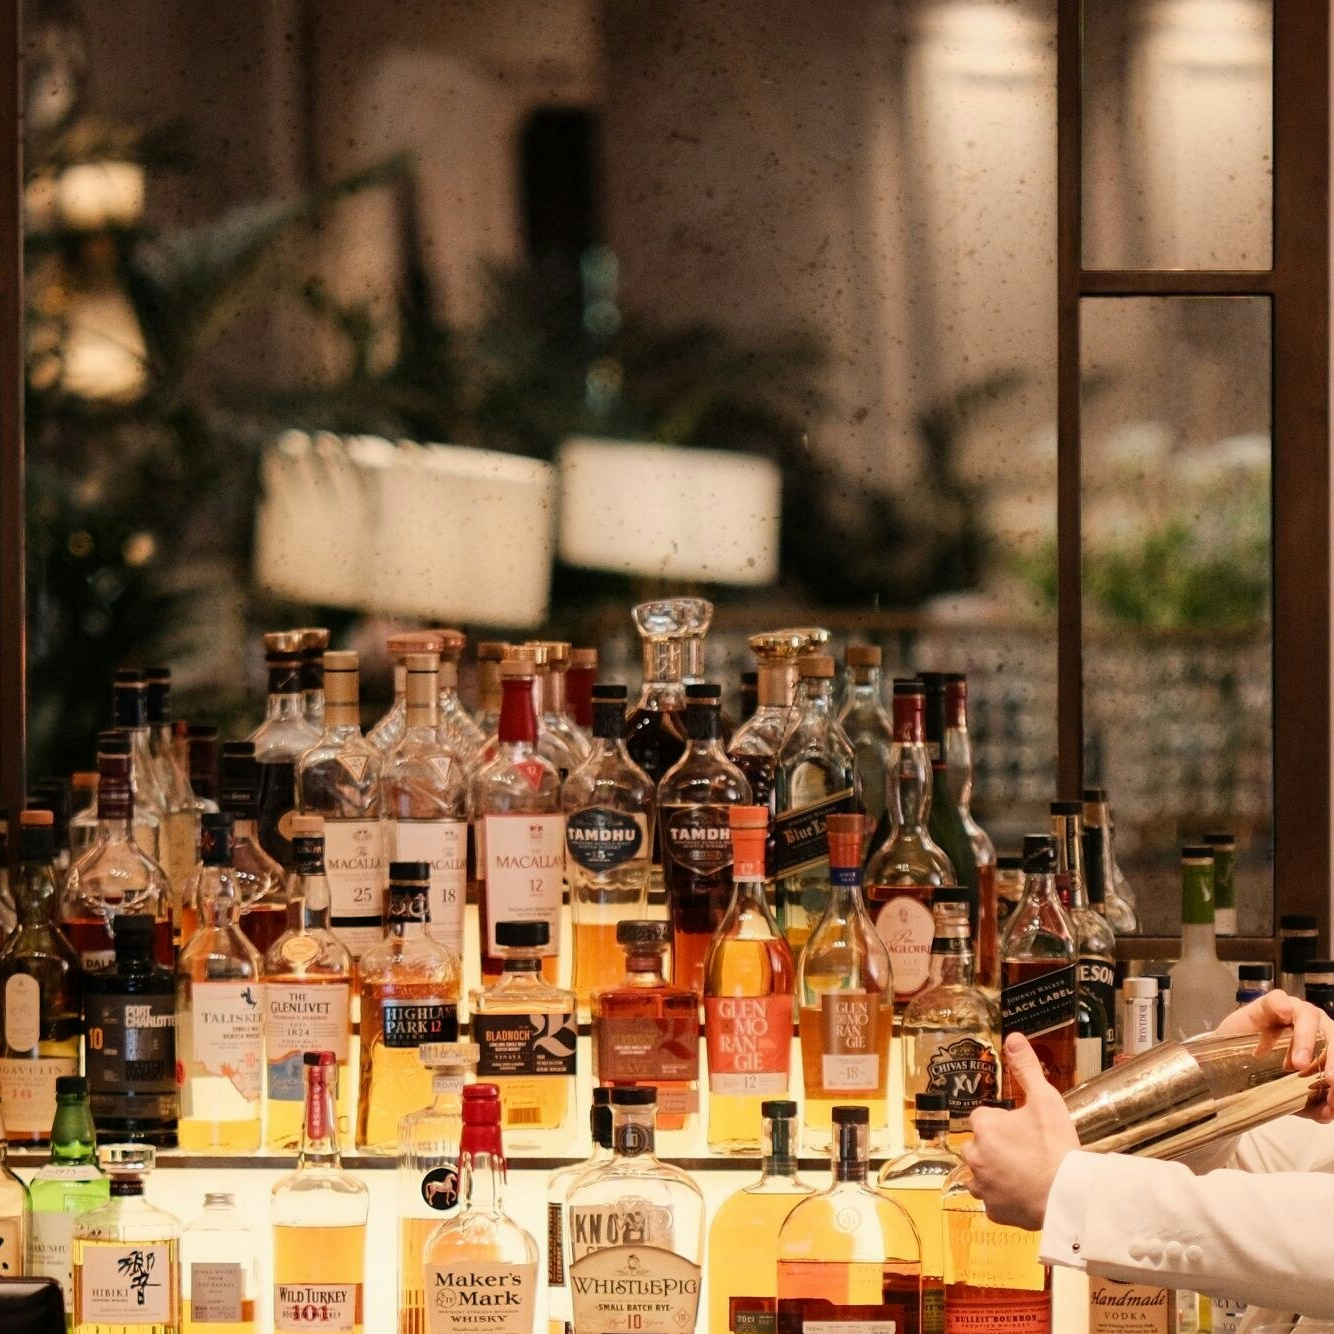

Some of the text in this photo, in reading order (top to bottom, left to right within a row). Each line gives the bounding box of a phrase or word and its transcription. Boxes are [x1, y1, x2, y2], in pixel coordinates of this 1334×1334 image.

[568, 827, 635, 841] TAMDHU
[670, 827, 730, 841] TAMDH
[741, 862, 754, 875] 12
[529, 879, 544, 892] 12
[353, 887, 372, 902] 25
[442, 888, 457, 903] 18
[289, 992, 308, 1001] THE
[1003, 988, 1074, 1018] BLACK LABEL
[270, 1001, 332, 1015] GLENLIVET
[385, 1007, 457, 1021] HIGHLAN
[719, 1000, 766, 1018] GLEN
[836, 1001, 867, 1013] GLEN
[846, 1014, 869, 1025] MO
[287, 1028, 310, 1037] 1824
[385, 1020, 442, 1034] PARK 12
[734, 1019, 768, 1036] MO
[836, 1025, 861, 1037] RAN
[88, 1027, 103, 1050] 10
[485, 1029, 531, 1042] BLADNOCH
[720, 1035, 757, 1053] RAN
[846, 1037, 866, 1049] GIE
[733, 1053, 764, 1071] GIE
[931, 1061, 996, 1075] CHIVAS REGAL
[845, 1067, 859, 1080] 18
[743, 1075, 757, 1089] 12
[953, 1073, 982, 1098] XV
[435, 1272, 522, 1287] Maker's
[92, 1288, 129, 1298] HIBIKI
[279, 1287, 347, 1304] WILD TURKEY
[458, 1290, 522, 1306] Mark
[1091, 1288, 1166, 1307] Handmade
[292, 1304, 329, 1321] 101
[627, 1303, 653, 1312] BATCH
[450, 1315, 508, 1323] WHISKY
[627, 1313, 642, 1330] 10
[954, 1314, 1037, 1323] BULLEIT BOURBON
[1104, 1311, 1148, 1320] VODKA
